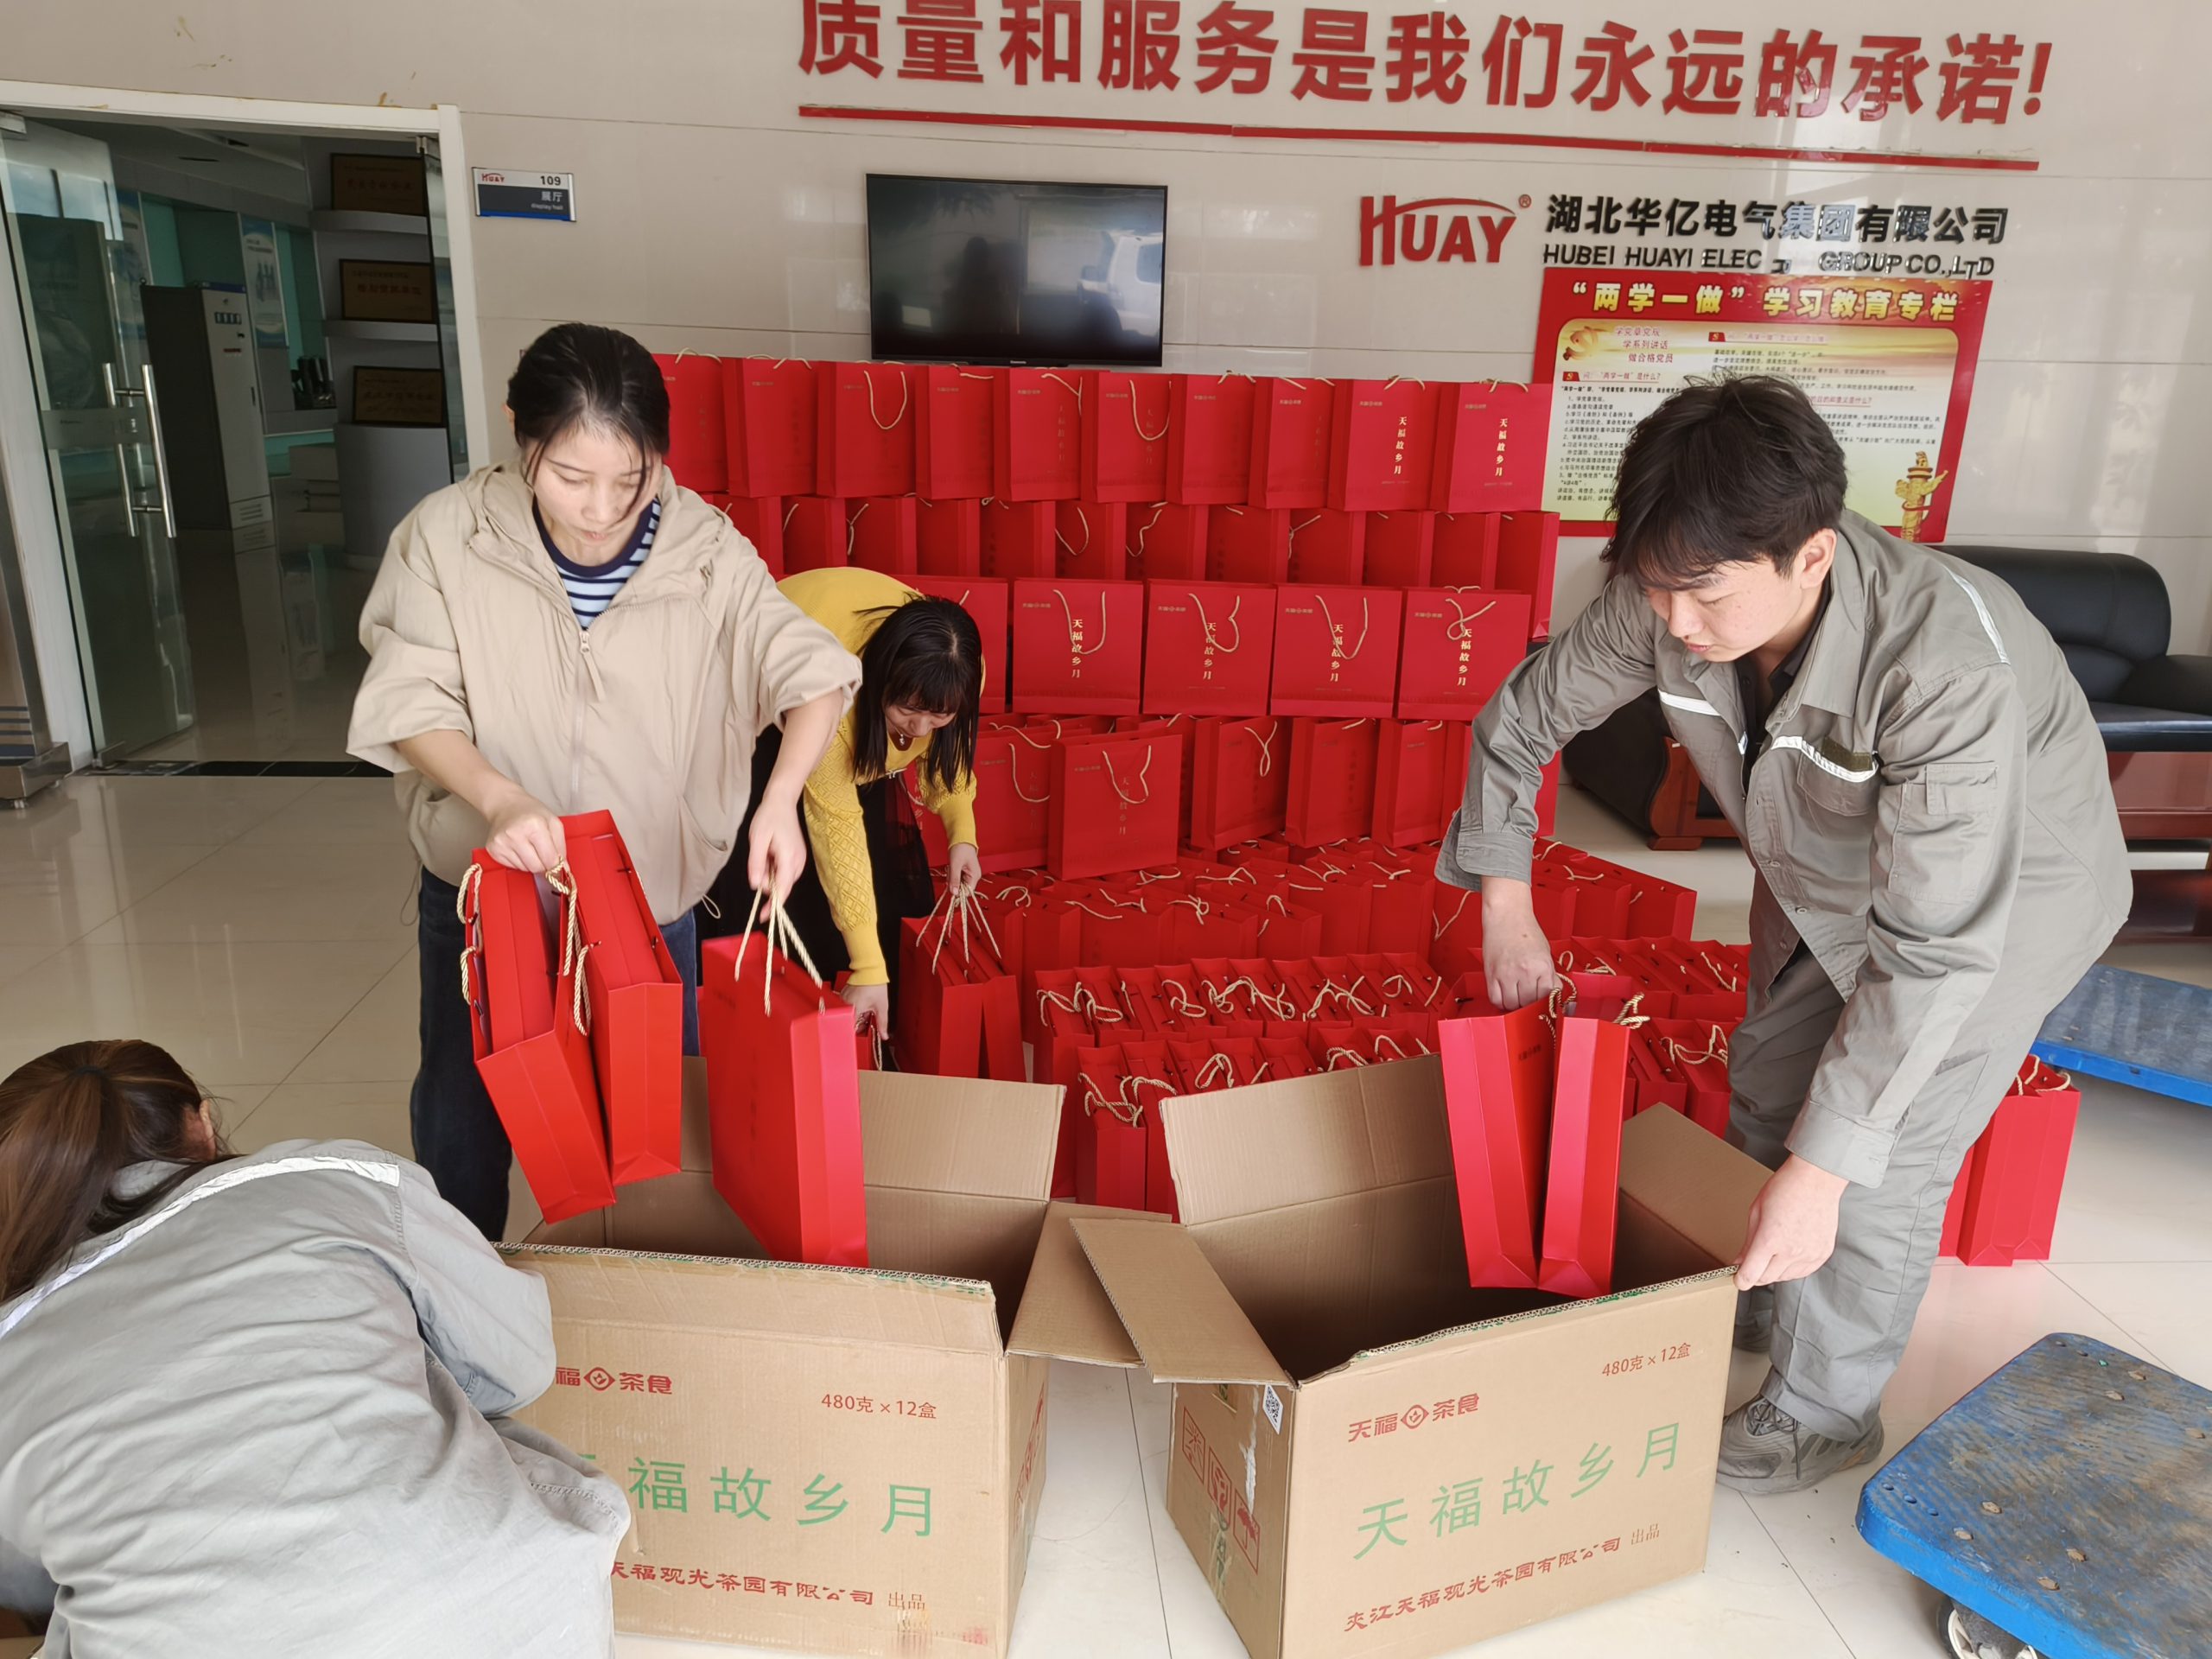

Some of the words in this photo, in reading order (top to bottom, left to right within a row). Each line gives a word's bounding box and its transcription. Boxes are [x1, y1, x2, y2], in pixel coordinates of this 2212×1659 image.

[798, 0, 2052, 125] 质量和服务是我们永远的承诺!
[540, 175, 562, 186] 109
[541, 191, 563, 202] 展厅
[1546, 194, 2010, 245] 湖北华亿电气集团有限公司
[1543, 244, 1615, 266] HUBEI
[1624, 247, 1694, 270] HUAYI
[1818, 251, 1903, 275] GROUP
[1764, 286, 1960, 321] 学习教育专栏
[1394, 416, 1408, 475] 天福故乡月
[1495, 417, 1509, 477] 天福故乡月
[619, 1371, 673, 1395] 茶食
[1348, 1409, 1398, 1443] 天福
[1431, 1392, 1480, 1422] 茶食
[579, 1453, 932, 1538] 福故乡月
[1353, 1421, 1681, 1561] 天福故乡月
[888, 1591, 926, 1611] 出品
[1344, 1536, 1622, 1633] 夹江天福观光茶园有限公司
[1630, 1523, 1661, 1548] 出品
